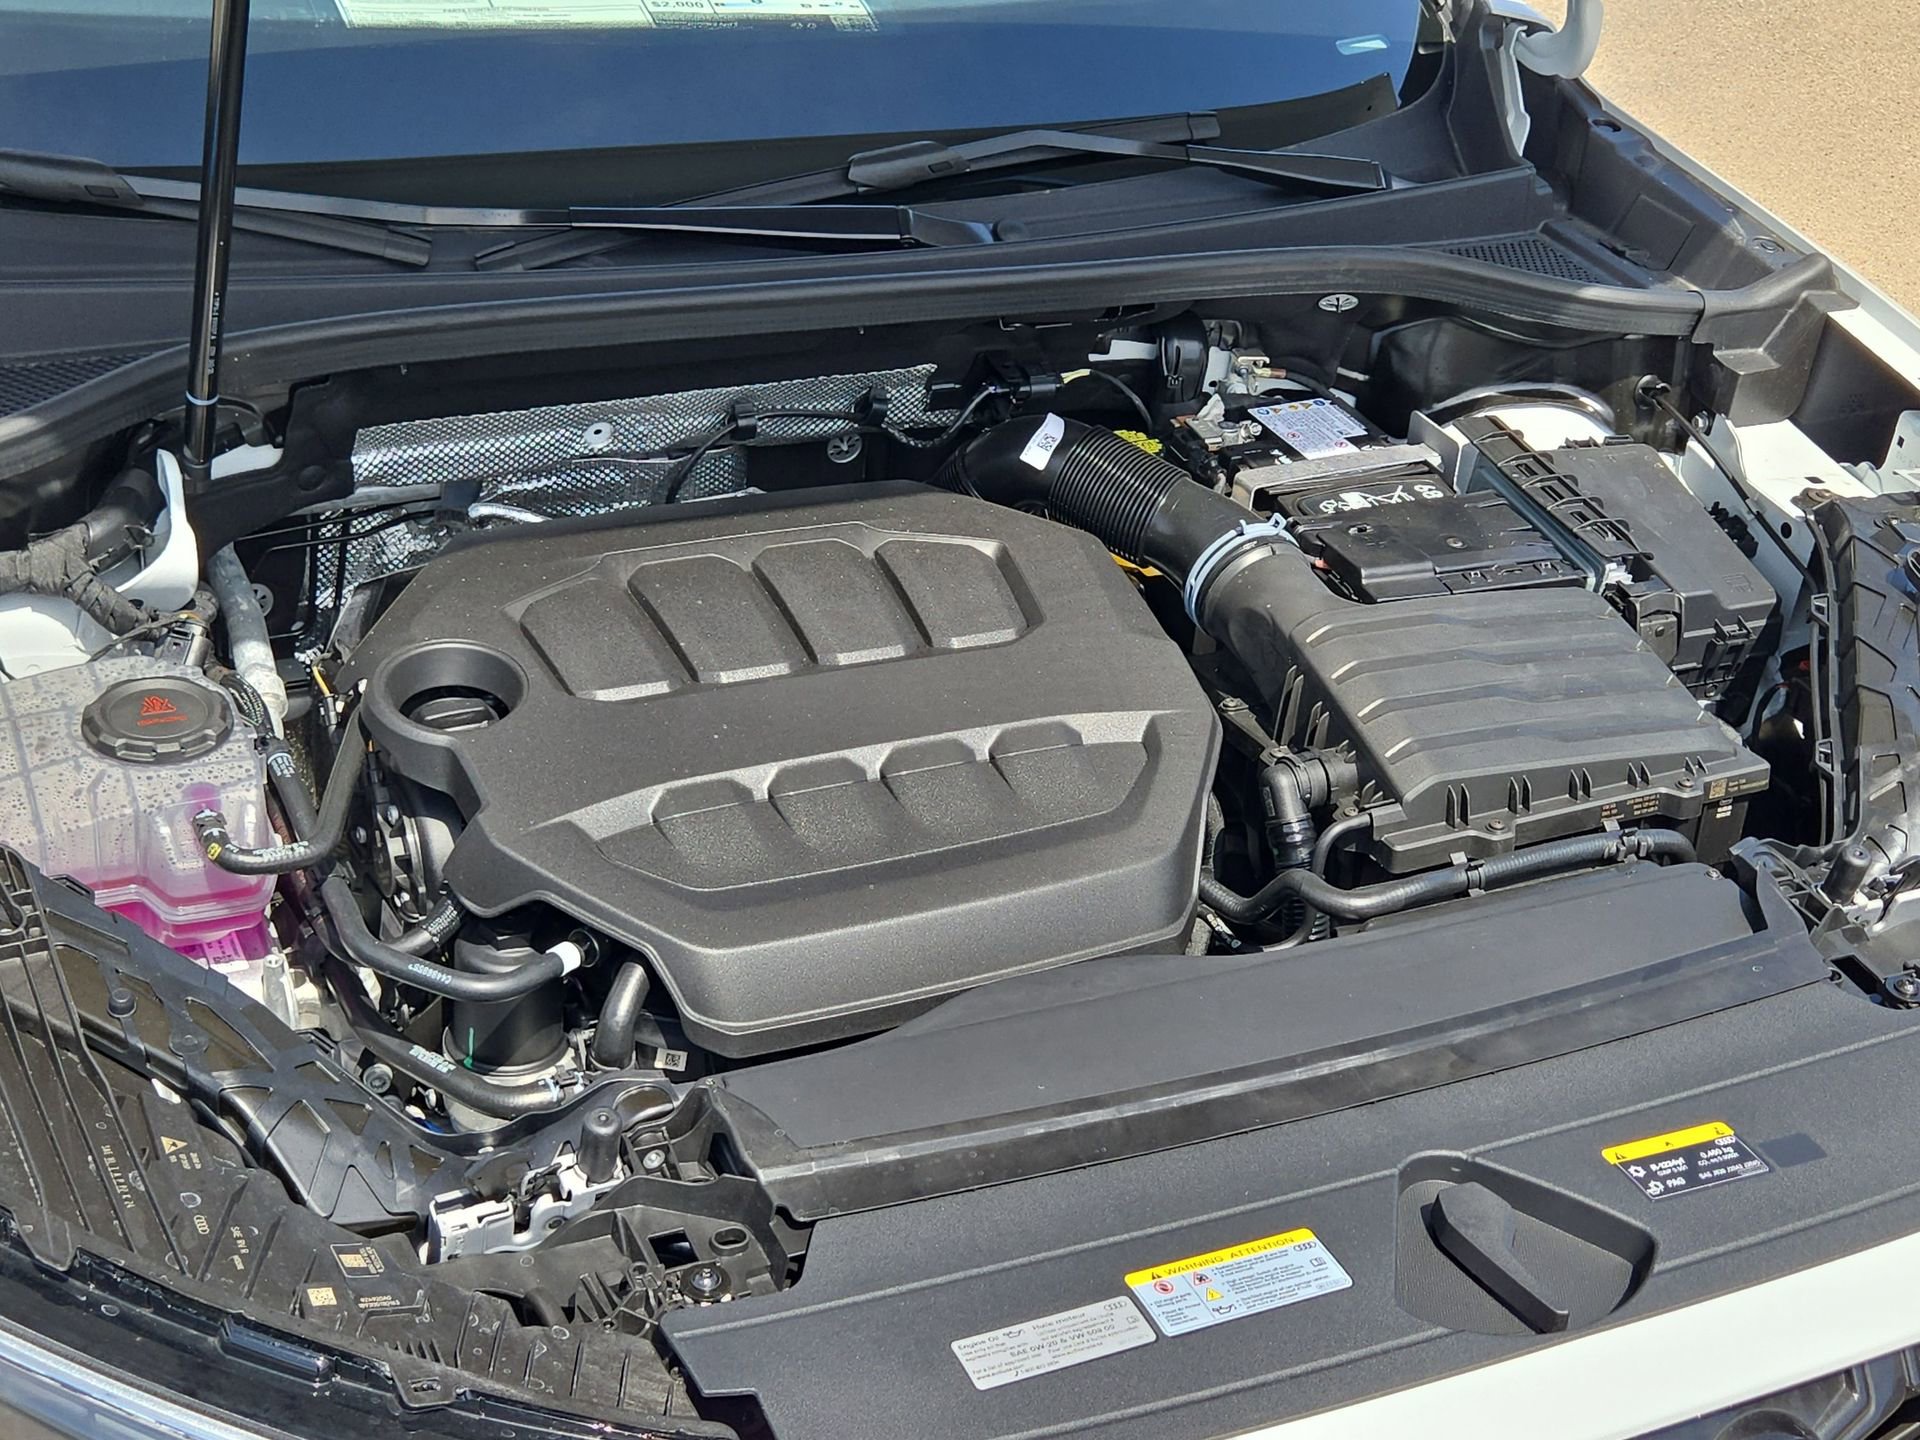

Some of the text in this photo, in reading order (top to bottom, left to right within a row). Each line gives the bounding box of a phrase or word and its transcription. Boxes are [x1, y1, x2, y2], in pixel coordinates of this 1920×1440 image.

[1164, 1256, 1224, 1275] WARNING
[1230, 1237, 1295, 1259] ATTENTION
[1069, 1333, 1085, 1341] VW
[958, 1340, 986, 1351] Engine
